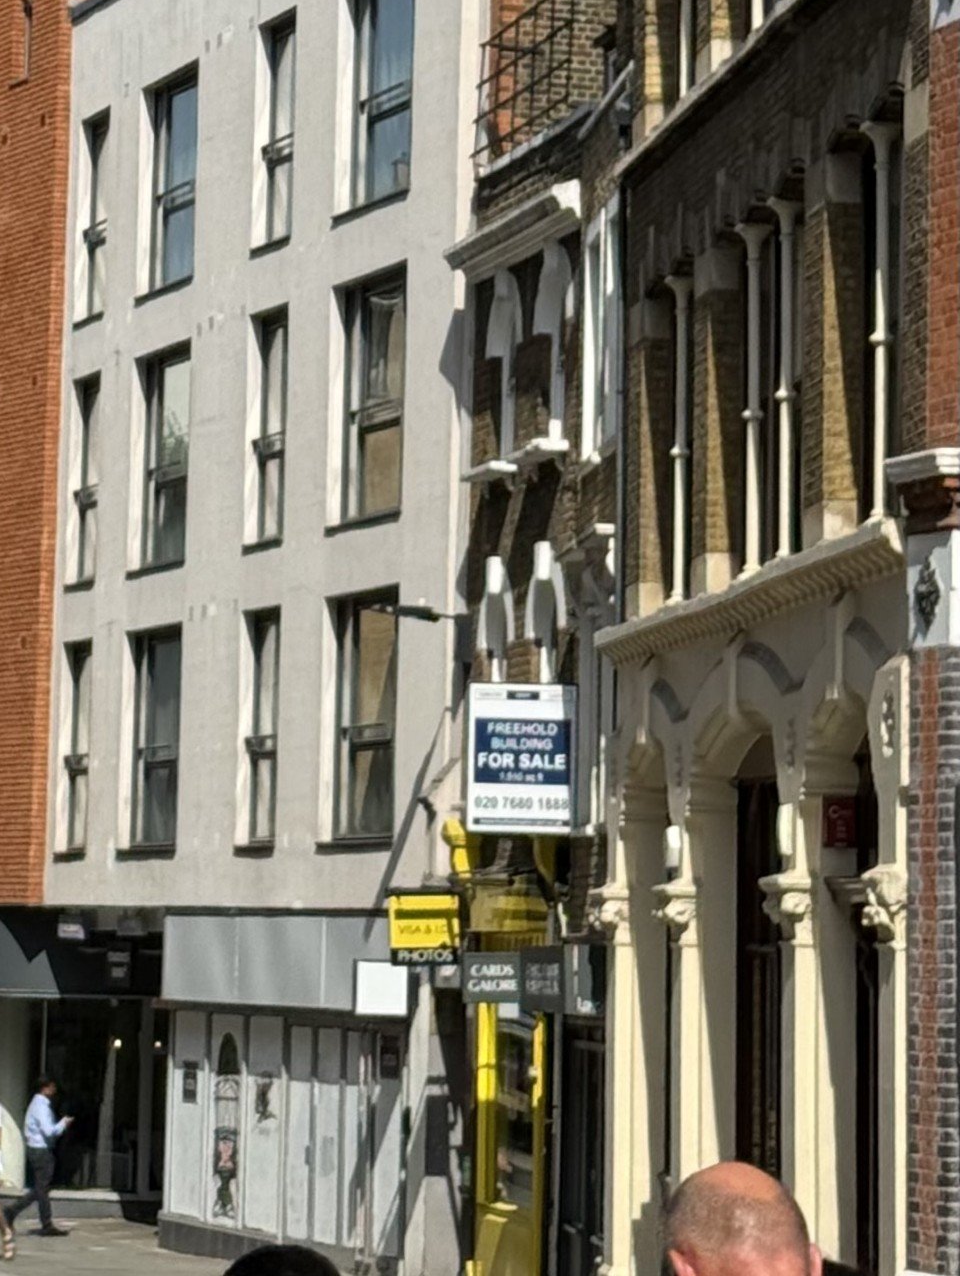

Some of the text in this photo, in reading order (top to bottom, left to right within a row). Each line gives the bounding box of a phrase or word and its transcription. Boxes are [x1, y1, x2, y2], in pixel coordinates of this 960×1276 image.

[486, 721, 559, 737] FREEHOLD
[490, 736, 554, 751] BUILDING
[477, 752, 567, 770] FOR SALE
[474, 795, 499, 809] 020
[397, 948, 454, 962] PHOTOS
[469, 963, 515, 977] CARDS
[466, 978, 519, 992] GALORE
